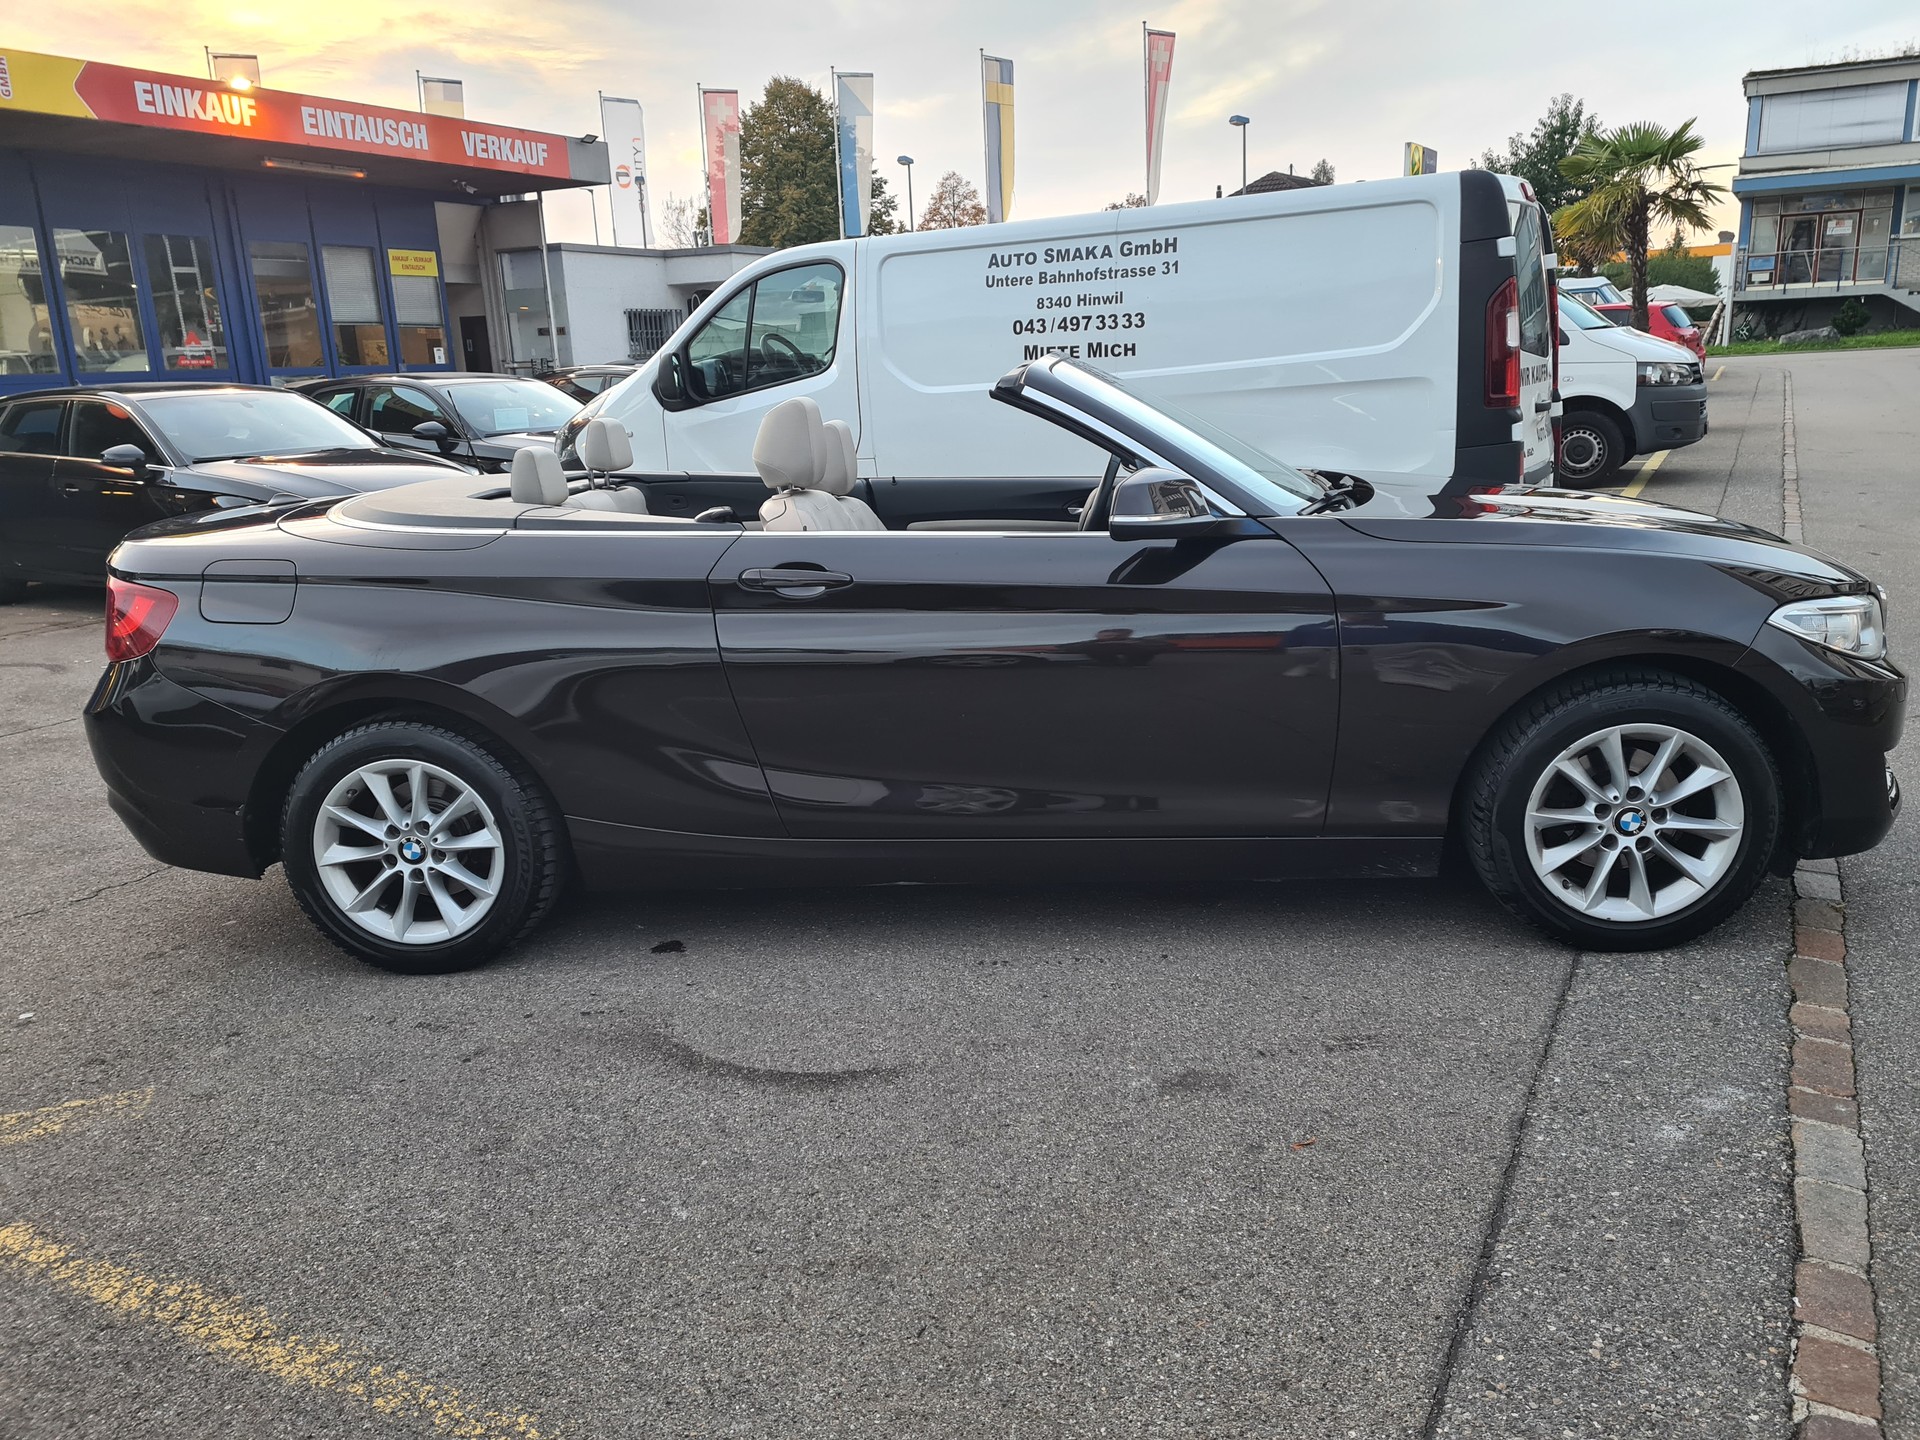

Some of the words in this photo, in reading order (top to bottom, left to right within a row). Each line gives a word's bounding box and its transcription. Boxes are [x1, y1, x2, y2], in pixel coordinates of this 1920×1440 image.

[133, 80, 257, 127] EINKAUF
[300, 105, 429, 150] EINTAUSCH
[461, 130, 548, 167] VERKAUF
[987, 252, 1037, 268] AUTO
[1043, 245, 1113, 264] SMAKA
[1119, 237, 1178, 257] GmbH
[985, 275, 1034, 288] Untere
[1038, 265, 1157, 285] Bahnhofstrasse
[1161, 260, 1179, 275] 31
[1036, 296, 1072, 310] 8340
[1076, 291, 1124, 307] Hinwil
